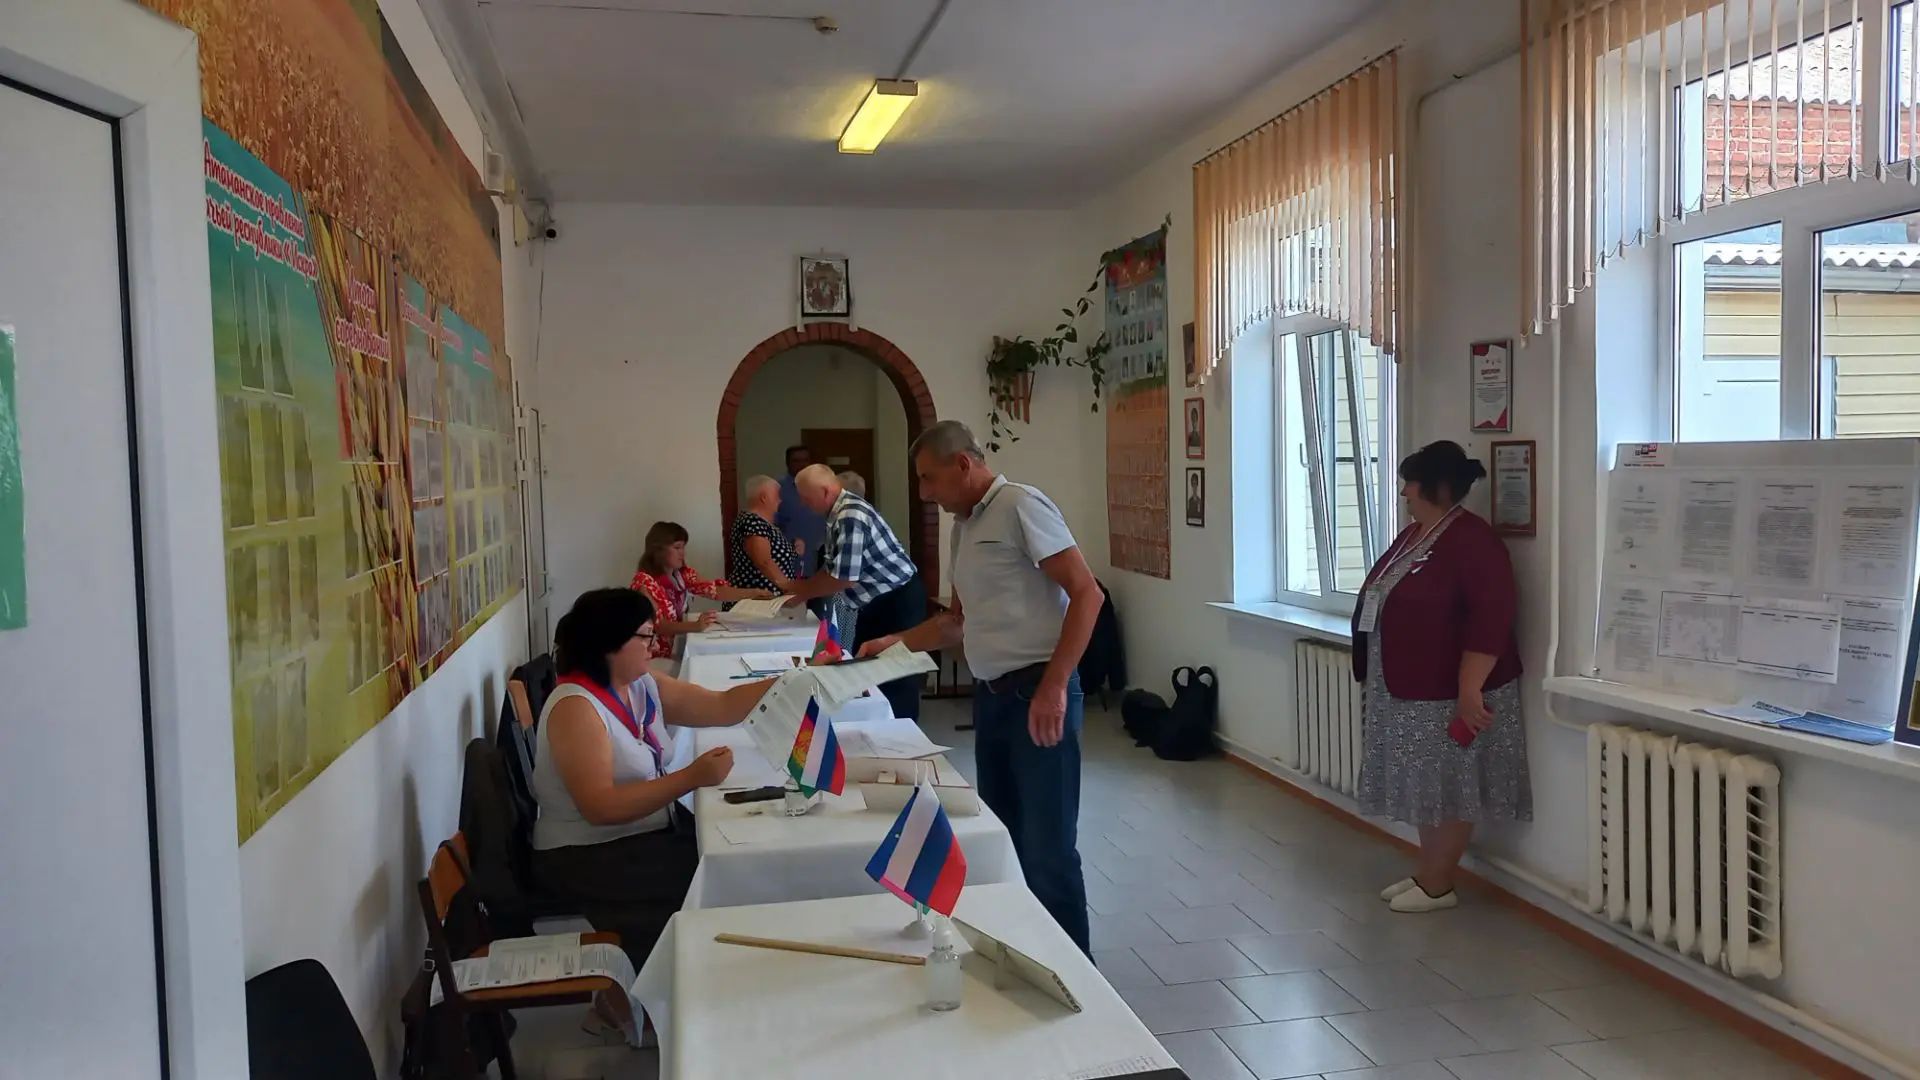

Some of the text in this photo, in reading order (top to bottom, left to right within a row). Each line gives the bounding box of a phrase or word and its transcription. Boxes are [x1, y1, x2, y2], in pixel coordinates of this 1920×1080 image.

[204, 138, 306, 241] Атаманское правление
[233, 214, 284, 262] республики
